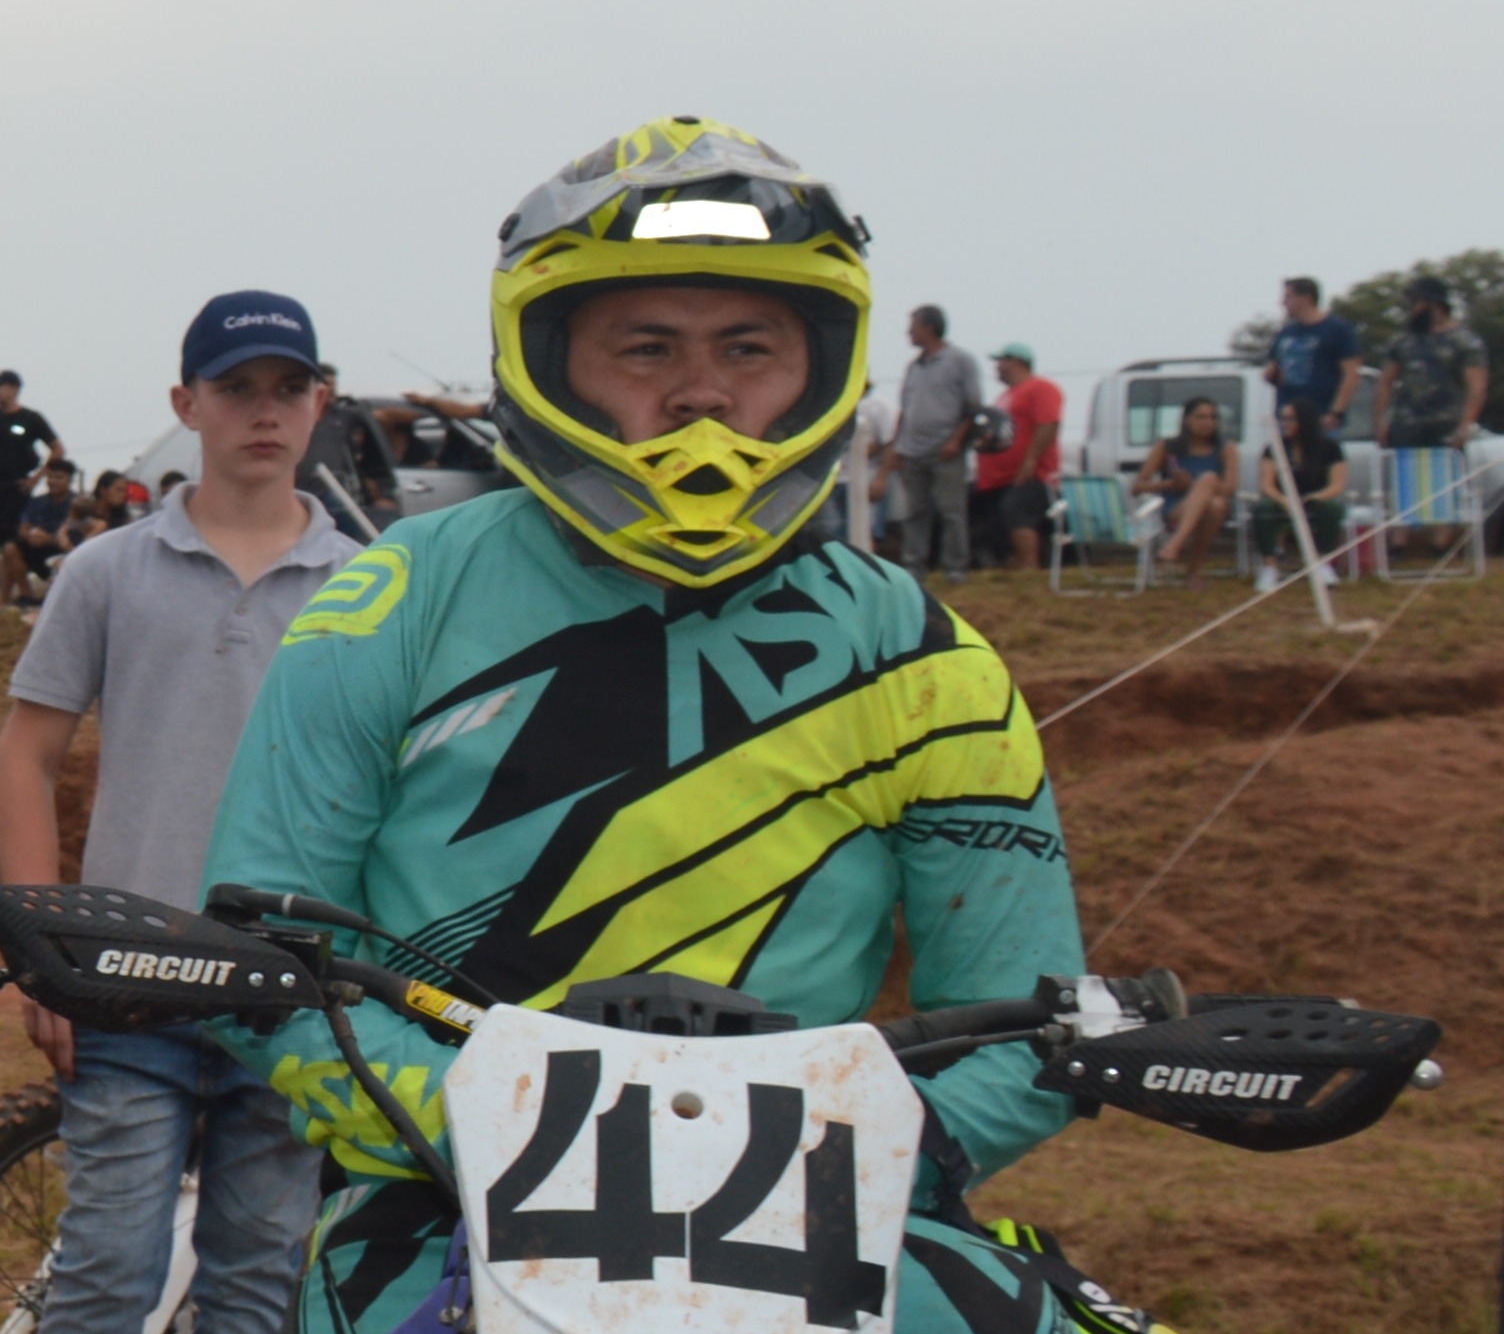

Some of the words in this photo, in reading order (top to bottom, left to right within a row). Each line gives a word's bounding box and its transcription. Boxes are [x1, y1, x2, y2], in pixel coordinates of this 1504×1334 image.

[96, 949, 236, 986] CIRCUIT
[1142, 1064, 1302, 1101] CIRCUIT
[486, 1049, 887, 1330] 44
